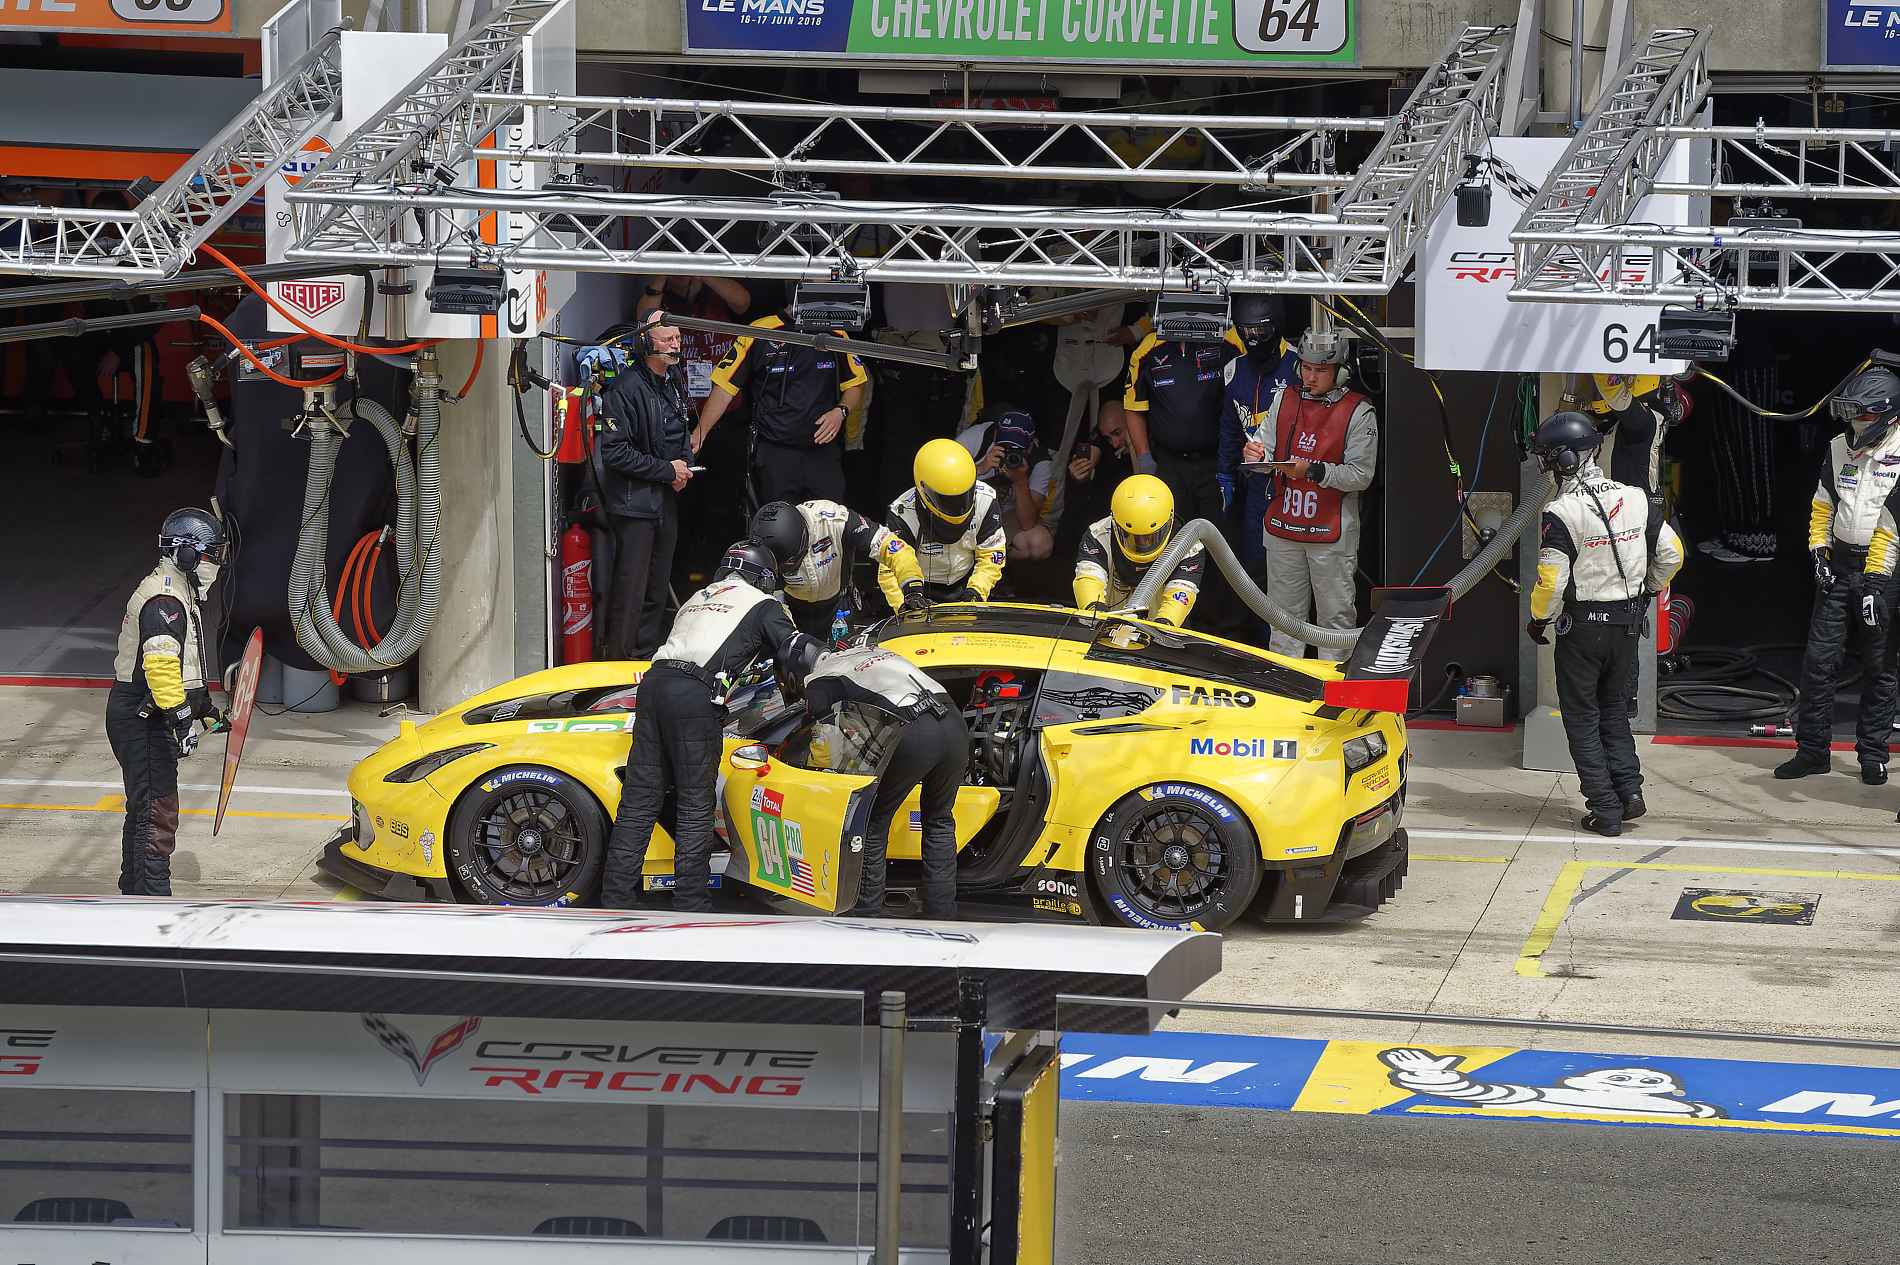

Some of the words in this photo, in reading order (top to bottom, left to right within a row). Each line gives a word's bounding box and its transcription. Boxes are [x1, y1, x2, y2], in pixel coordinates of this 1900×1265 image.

[701, 0, 737, 12] LE
[741, 0, 825, 15] MANS
[740, 15, 767, 25] 16-17
[771, 16, 795, 25] JUIN
[797, 16, 822, 26] 2018
[1258, 0, 1320, 42] 64
[871, 0, 1047, 41] CHEVROLET
[1062, 0, 1219, 44] CORVETTE
[283, 284, 339, 312] HEUER
[1603, 323, 1659, 364] 64
[1282, 487, 1318, 519] 896
[1171, 684, 1256, 708] FARO
[1190, 738, 1265, 757] Mobil
[501, 771, 557, 784] MICHELIN
[763, 795, 781, 813] TOTAL
[1166, 785, 1231, 819] MICHELIN
[390, 818, 409, 838] BBS
[756, 816, 785, 880] 64
[1033, 897, 1067, 908] braille
[476, 1040, 819, 1069] CORVETTE
[469, 1067, 805, 1097] RACING
